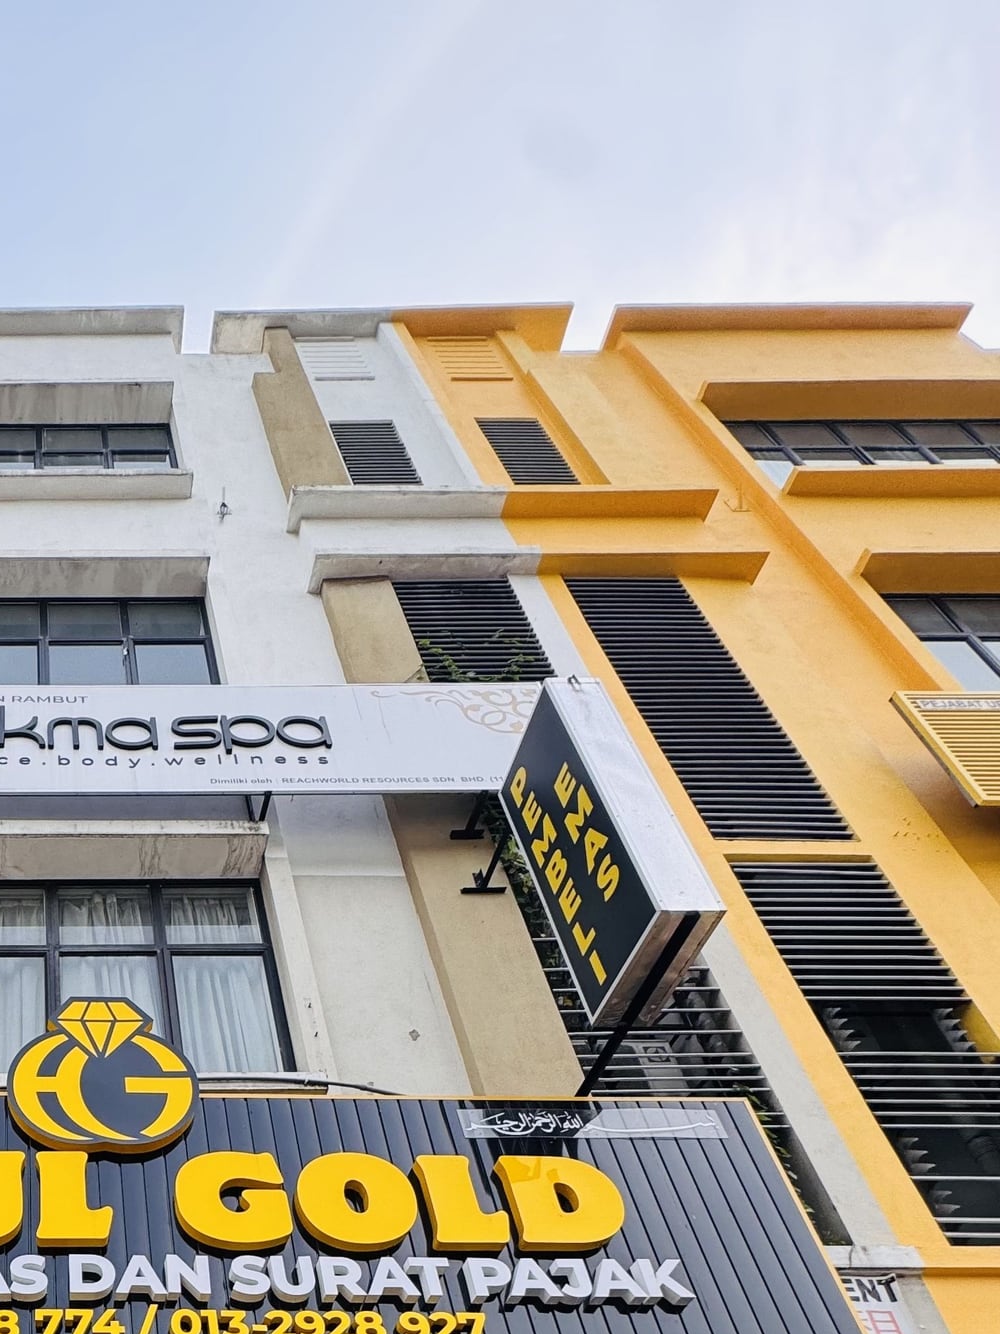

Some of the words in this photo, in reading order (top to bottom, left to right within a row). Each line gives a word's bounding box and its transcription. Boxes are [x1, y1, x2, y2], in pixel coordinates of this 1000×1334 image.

[11, 695, 88, 704] RAMBUT
[171, 715, 332, 754] spa
[554, 762, 620, 903] EMAS
[510, 766, 607, 986] PEMBELI
[175, 1150, 625, 1253] GOLD
[65, 1253, 217, 1303] DAN
[228, 1253, 452, 1305] SURAT
[461, 1256, 696, 1306] PAJAK
